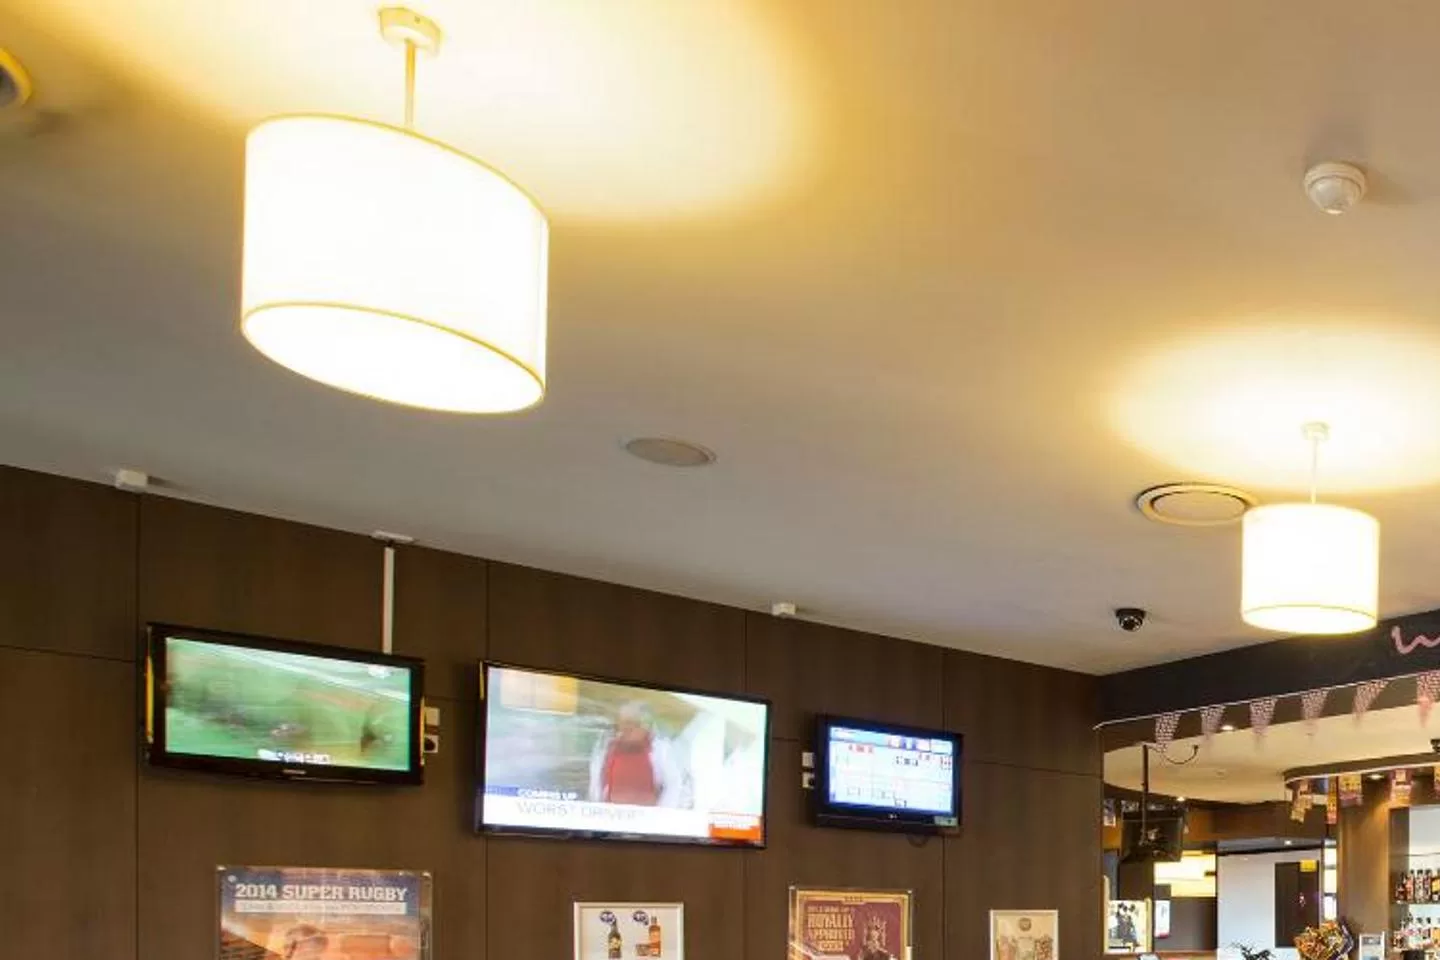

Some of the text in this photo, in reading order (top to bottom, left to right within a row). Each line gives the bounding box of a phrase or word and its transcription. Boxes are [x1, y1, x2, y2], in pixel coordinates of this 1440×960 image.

[562, 791, 578, 801] UP
[234, 883, 408, 901] 2014 SUPER RUGBY
